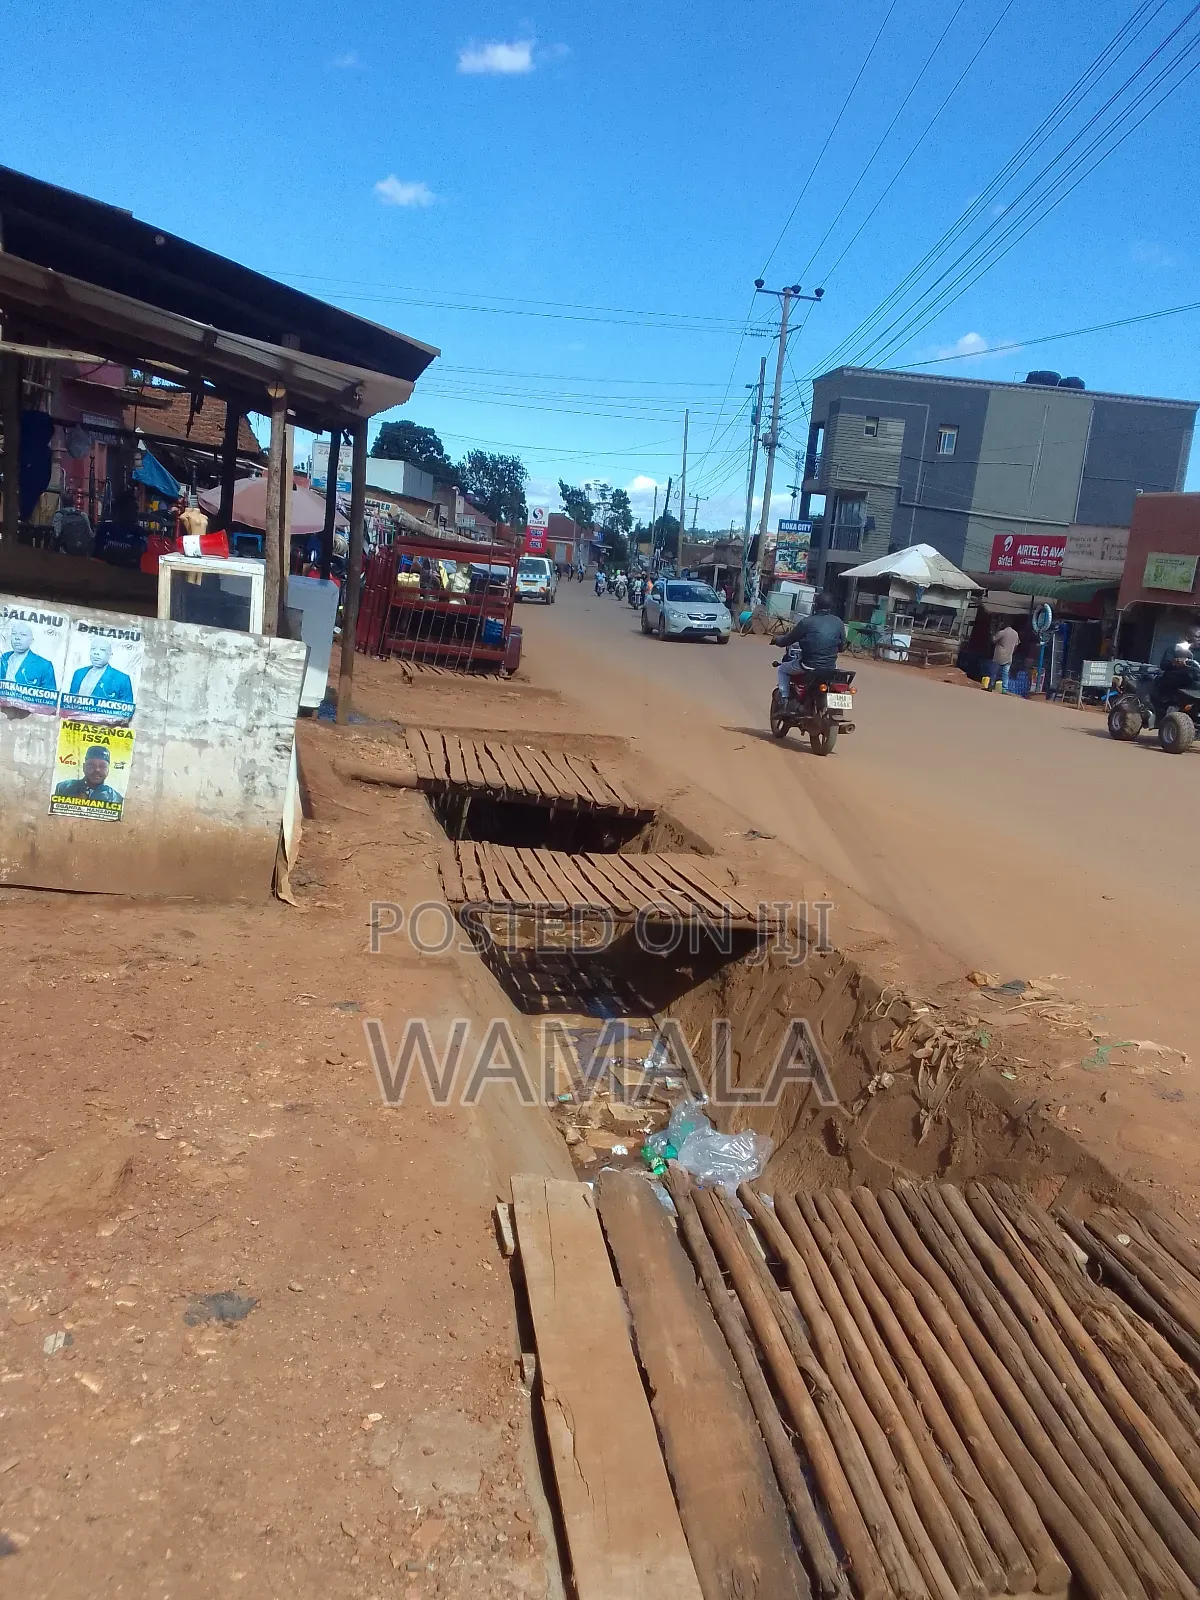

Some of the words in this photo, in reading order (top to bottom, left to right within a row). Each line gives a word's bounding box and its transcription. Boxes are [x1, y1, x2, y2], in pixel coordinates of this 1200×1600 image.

[797, 523, 812, 532] CITY
[1017, 544, 1040, 557] AIRTEL
[1041, 545, 1050, 557] IS
[997, 554, 1013, 567] airtel
[77, 622, 141, 642] BALAMU
[63, 694, 95, 706] KITAKA
[96, 699, 135, 712] JACKSON
[62, 721, 134, 740] MBASANGA
[59, 753, 77, 766] Vote
[51, 795, 105, 808] CHAIRMAN
